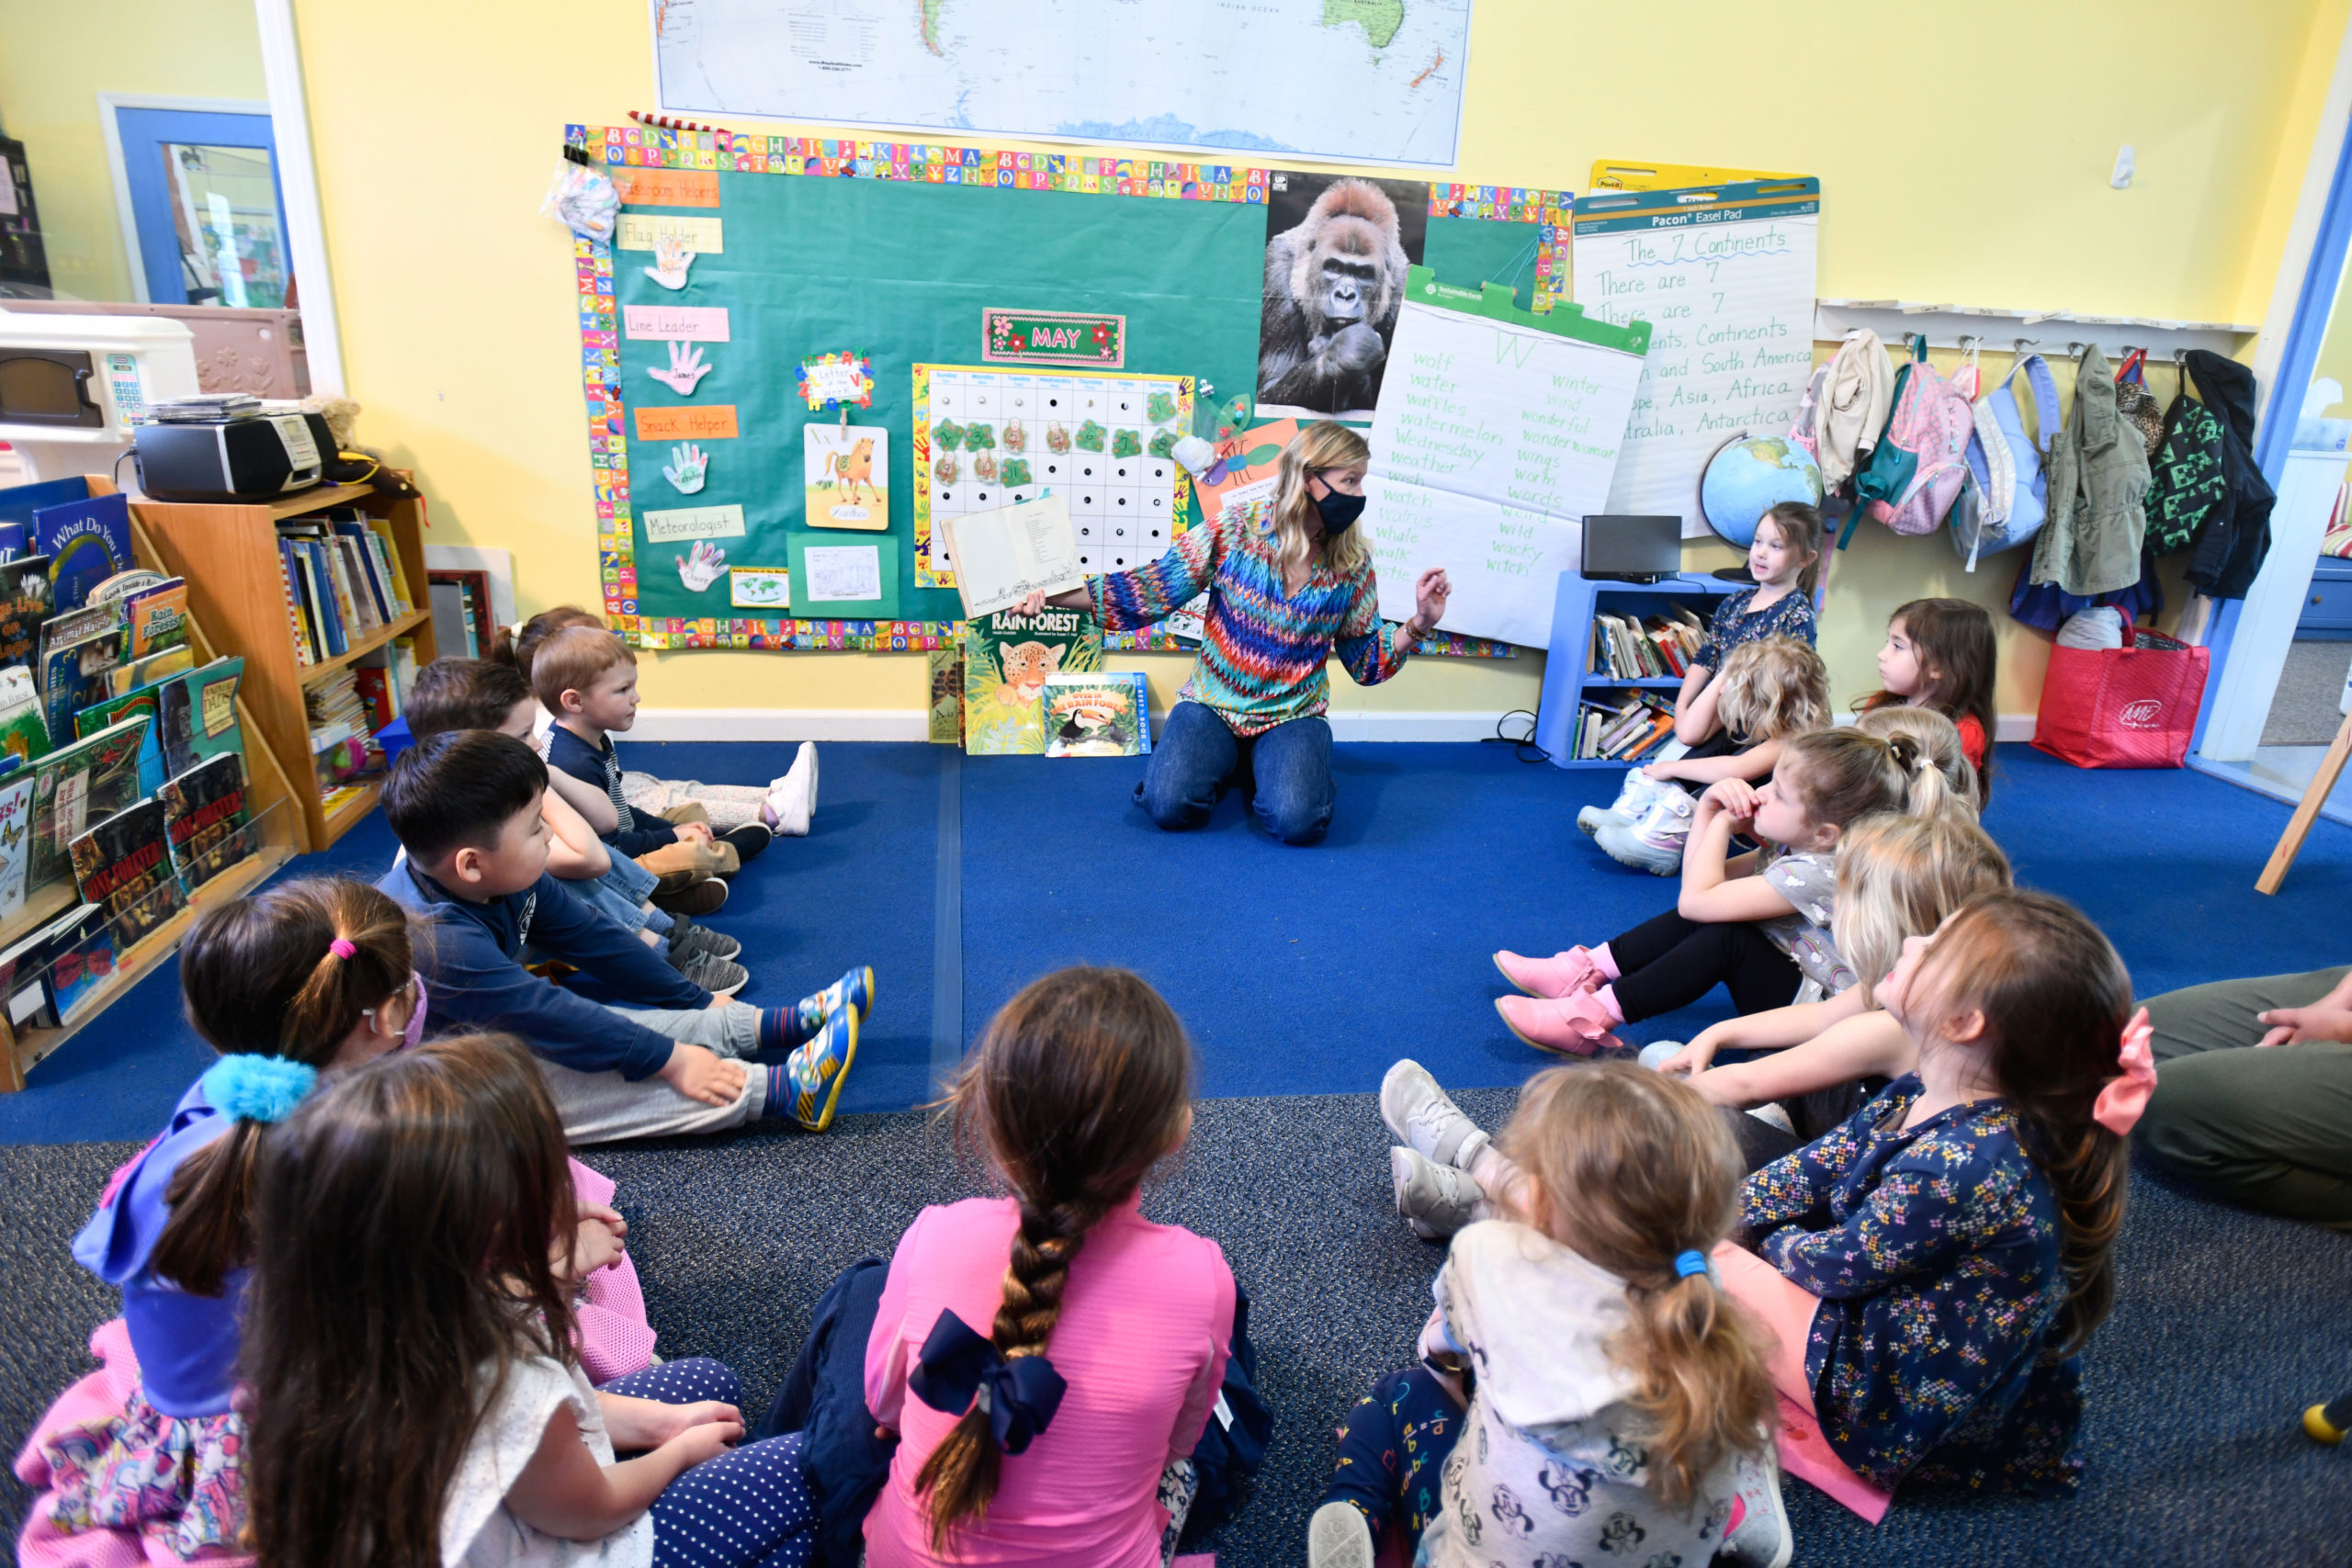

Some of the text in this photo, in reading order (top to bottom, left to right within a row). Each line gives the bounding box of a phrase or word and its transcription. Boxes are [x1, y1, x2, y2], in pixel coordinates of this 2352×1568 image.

[677, 177, 718, 202] Helpers
[1695, 210, 1722, 223] Easel
[1723, 209, 1742, 220] Pad
[624, 222, 654, 249] Flag
[1623, 224, 1786, 261] The 7 Continents
[1595, 261, 1720, 297] There are 7
[1439, 285, 1484, 302] Sustainable Earth
[1662, 303, 1691, 319] are
[1712, 292, 1724, 314] 7
[628, 313, 700, 333] Line Leader
[1696, 316, 1787, 346] Continents
[1031, 327, 1081, 349] MAY
[1497, 329, 1540, 370] W
[1413, 351, 1455, 373] wolf
[1659, 358, 1689, 379] and
[1702, 352, 1745, 376] South
[1752, 347, 1813, 369] America
[1409, 372, 1460, 395] water
[1552, 374, 1605, 396] winter
[1725, 378, 1792, 401] Africa
[1406, 392, 1467, 418] waffles
[690, 414, 729, 435] Helper
[1400, 412, 1505, 446] watermelon
[1521, 410, 1591, 436] wonderful
[1696, 405, 1791, 434] Antarctica
[1395, 426, 1486, 470] Wednesday
[1390, 450, 1462, 475] weather
[1517, 448, 1561, 474] wings
[1387, 469, 1425, 487] wish
[1514, 468, 1557, 487] worm
[1383, 489, 1432, 509] watch
[1507, 484, 1564, 509] words
[649, 513, 732, 536] Meteorologist
[1378, 506, 1434, 530] walrus
[1499, 503, 1550, 525] weird
[51, 519, 85, 550] What
[85, 516, 102, 534] Do
[102, 525, 118, 552] You
[1375, 524, 1419, 545] whale
[1498, 522, 1534, 540] wild
[1374, 546, 1412, 564] walk
[1491, 539, 1544, 568] wacky
[1486, 558, 1531, 578] witch
[17, 594, 45, 615] Live
[149, 606, 174, 623] Rain
[2, 620, 20, 637] on
[141, 615, 180, 640] Forests
[992, 612, 1080, 633] RAIN FOREST
[49, 626, 82, 649] Animal
[1067, 698, 1092, 709] RAIN
[169, 791, 244, 846] GONE FOREVER!
[84, 837, 165, 904] GONE FOREVER!
